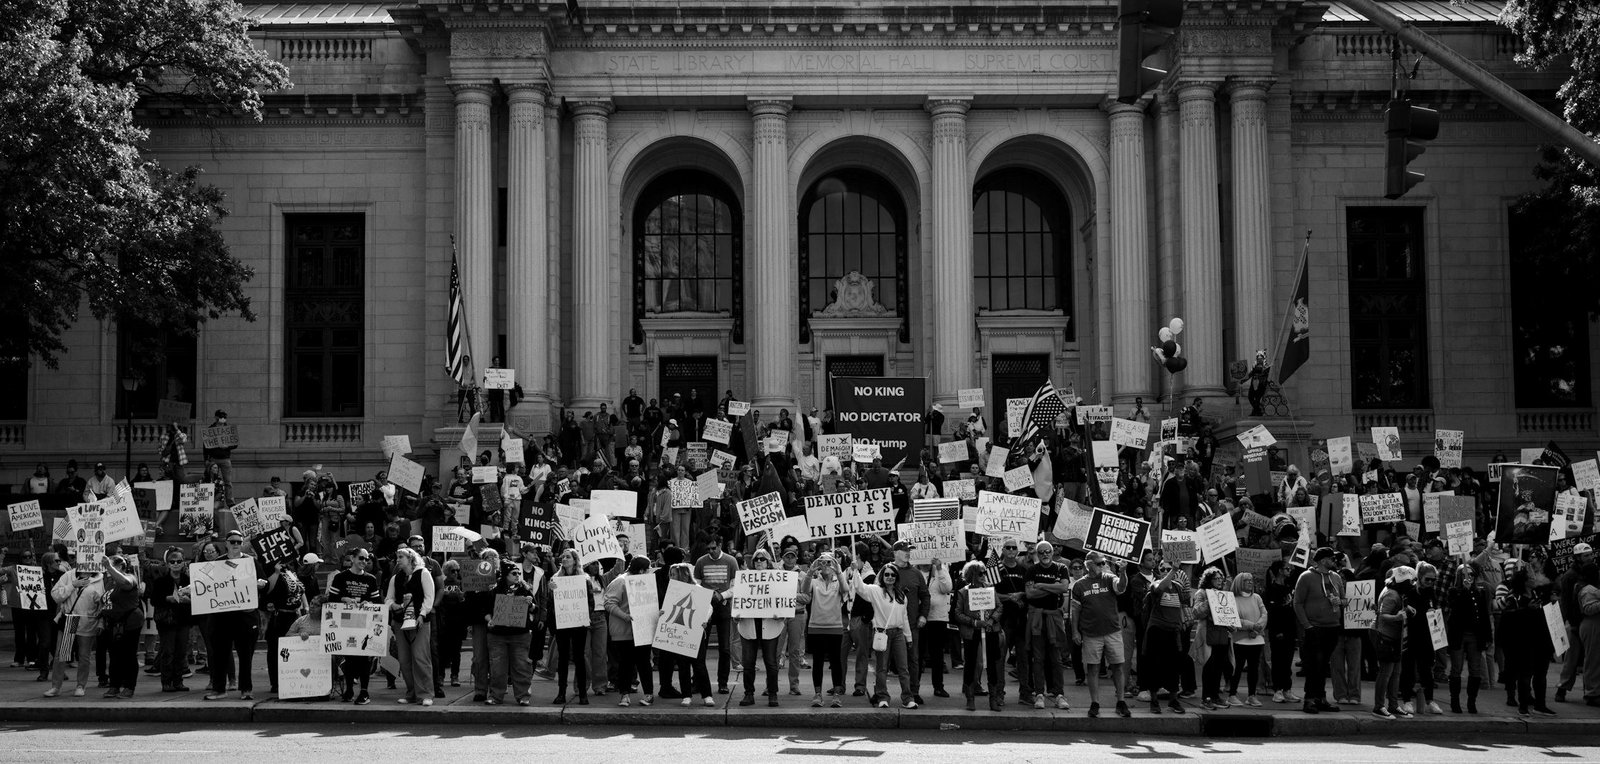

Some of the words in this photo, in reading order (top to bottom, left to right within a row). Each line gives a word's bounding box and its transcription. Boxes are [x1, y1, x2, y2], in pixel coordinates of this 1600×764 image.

[608, 55, 660, 71] STATE
[672, 55, 747, 71] LIBRARY
[788, 54, 883, 70] MEMORIAL
[888, 54, 933, 70] HALL
[966, 53, 1041, 70] SUPREME
[1050, 53, 1114, 70] COURT
[854, 386, 872, 396] NO
[875, 386, 904, 396] KING
[840, 412, 858, 422] NO
[861, 412, 921, 422] DICTATOR
[202, 426, 235, 437] RELEASE
[1116, 421, 1147, 434] RELEASE
[204, 439, 218, 447] THE
[221, 436, 238, 444] FILES
[872, 438, 907, 449] trump
[741, 492, 780, 512] FREEDOM
[807, 489, 888, 508] DEMOCRACY
[985, 493, 1039, 508] IMMIGRANTS
[10, 506, 18, 514] I
[20, 502, 38, 512] LOVE
[84, 504, 100, 512] LOVE
[532, 506, 544, 516] NO
[752, 504, 773, 516] NOT
[999, 507, 1036, 519] AMERICA
[11, 512, 40, 522] AMERICAN
[743, 510, 785, 531] FASCISM
[524, 518, 551, 529] KINGS
[810, 526, 826, 538] IN
[834, 519, 892, 535] SILENCE
[983, 518, 1027, 531] GREAT
[1101, 514, 1140, 533] VETERANS
[530, 531, 543, 540] NO
[575, 524, 612, 543] Ching
[1098, 524, 1138, 544] AGAINST
[258, 530, 290, 552] FUCK
[1095, 536, 1134, 557] TRUMP
[1163, 542, 1193, 551] WORKERS
[1554, 538, 1575, 550] WERE
[1579, 535, 1596, 544] NOT
[78, 545, 104, 553] FIGHTING
[580, 543, 595, 556] La
[1556, 548, 1574, 556] RAD
[1166, 552, 1192, 561] UNITE
[740, 572, 788, 583] RELEASE
[194, 575, 237, 597] Deport
[749, 584, 770, 595] THE
[1354, 582, 1371, 596] NO
[210, 586, 251, 609] Donald!
[554, 588, 586, 599] REVOLUTION
[733, 598, 772, 609] EPSTEIN
[775, 597, 796, 608] FILES
[660, 623, 677, 635] Elect
[325, 632, 336, 642] NO
[324, 642, 342, 653] KING
